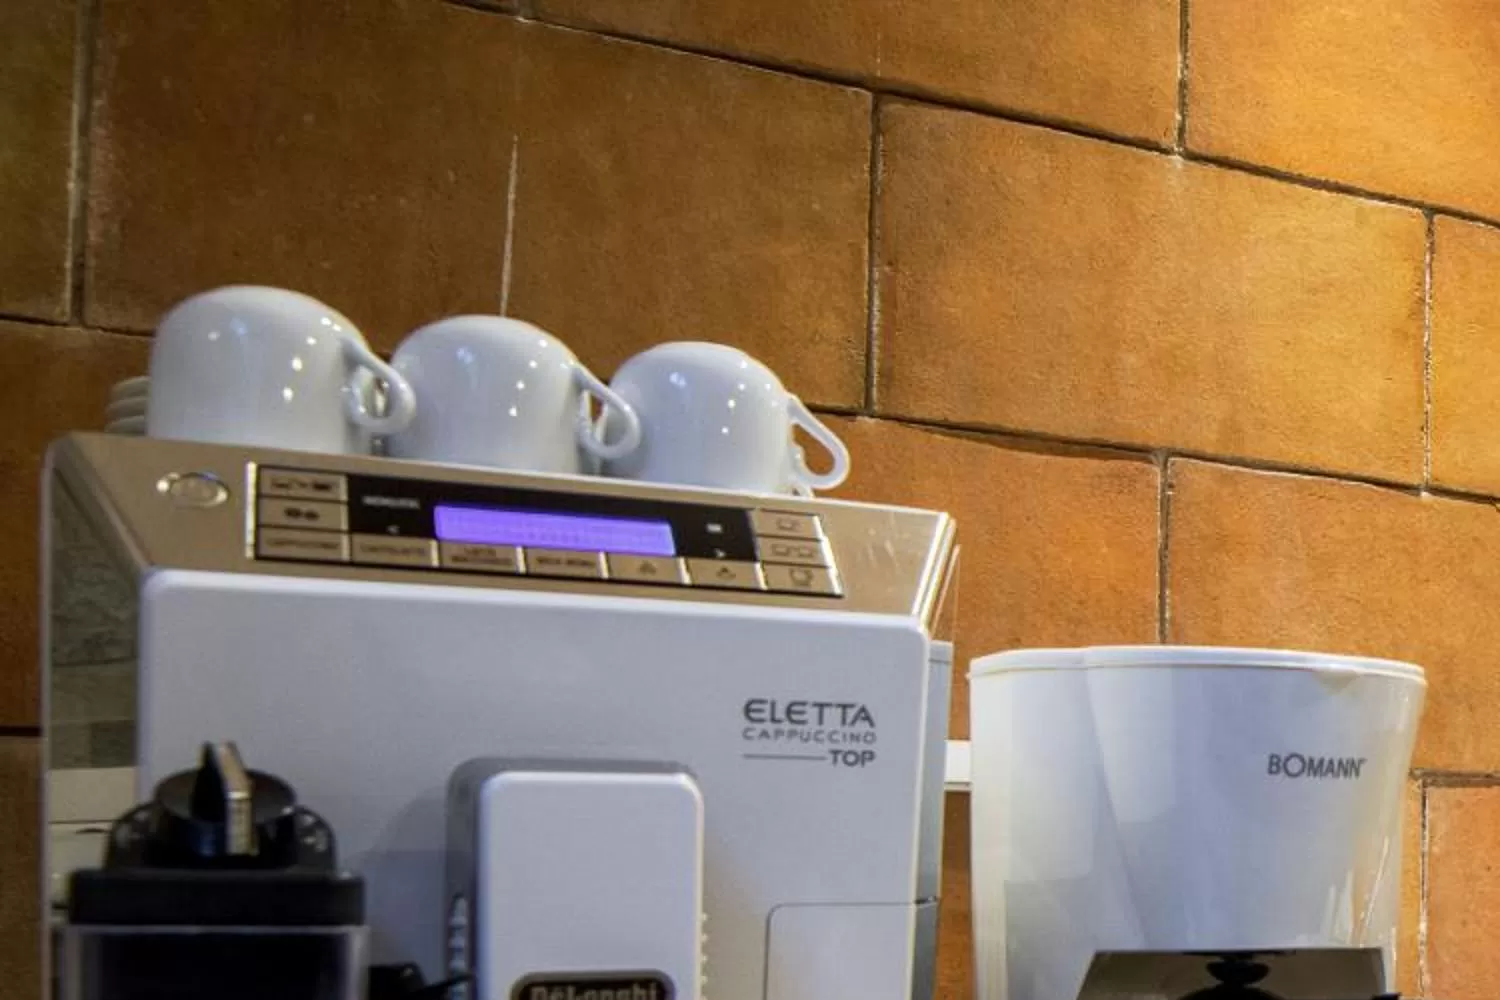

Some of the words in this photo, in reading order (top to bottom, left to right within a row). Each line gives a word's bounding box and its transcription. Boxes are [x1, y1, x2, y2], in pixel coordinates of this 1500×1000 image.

[743, 697, 876, 729] ELETTA
[742, 727, 877, 745] CAPPUCCINO
[828, 749, 877, 768] TOP
[1267, 752, 1363, 778] BOMANN
